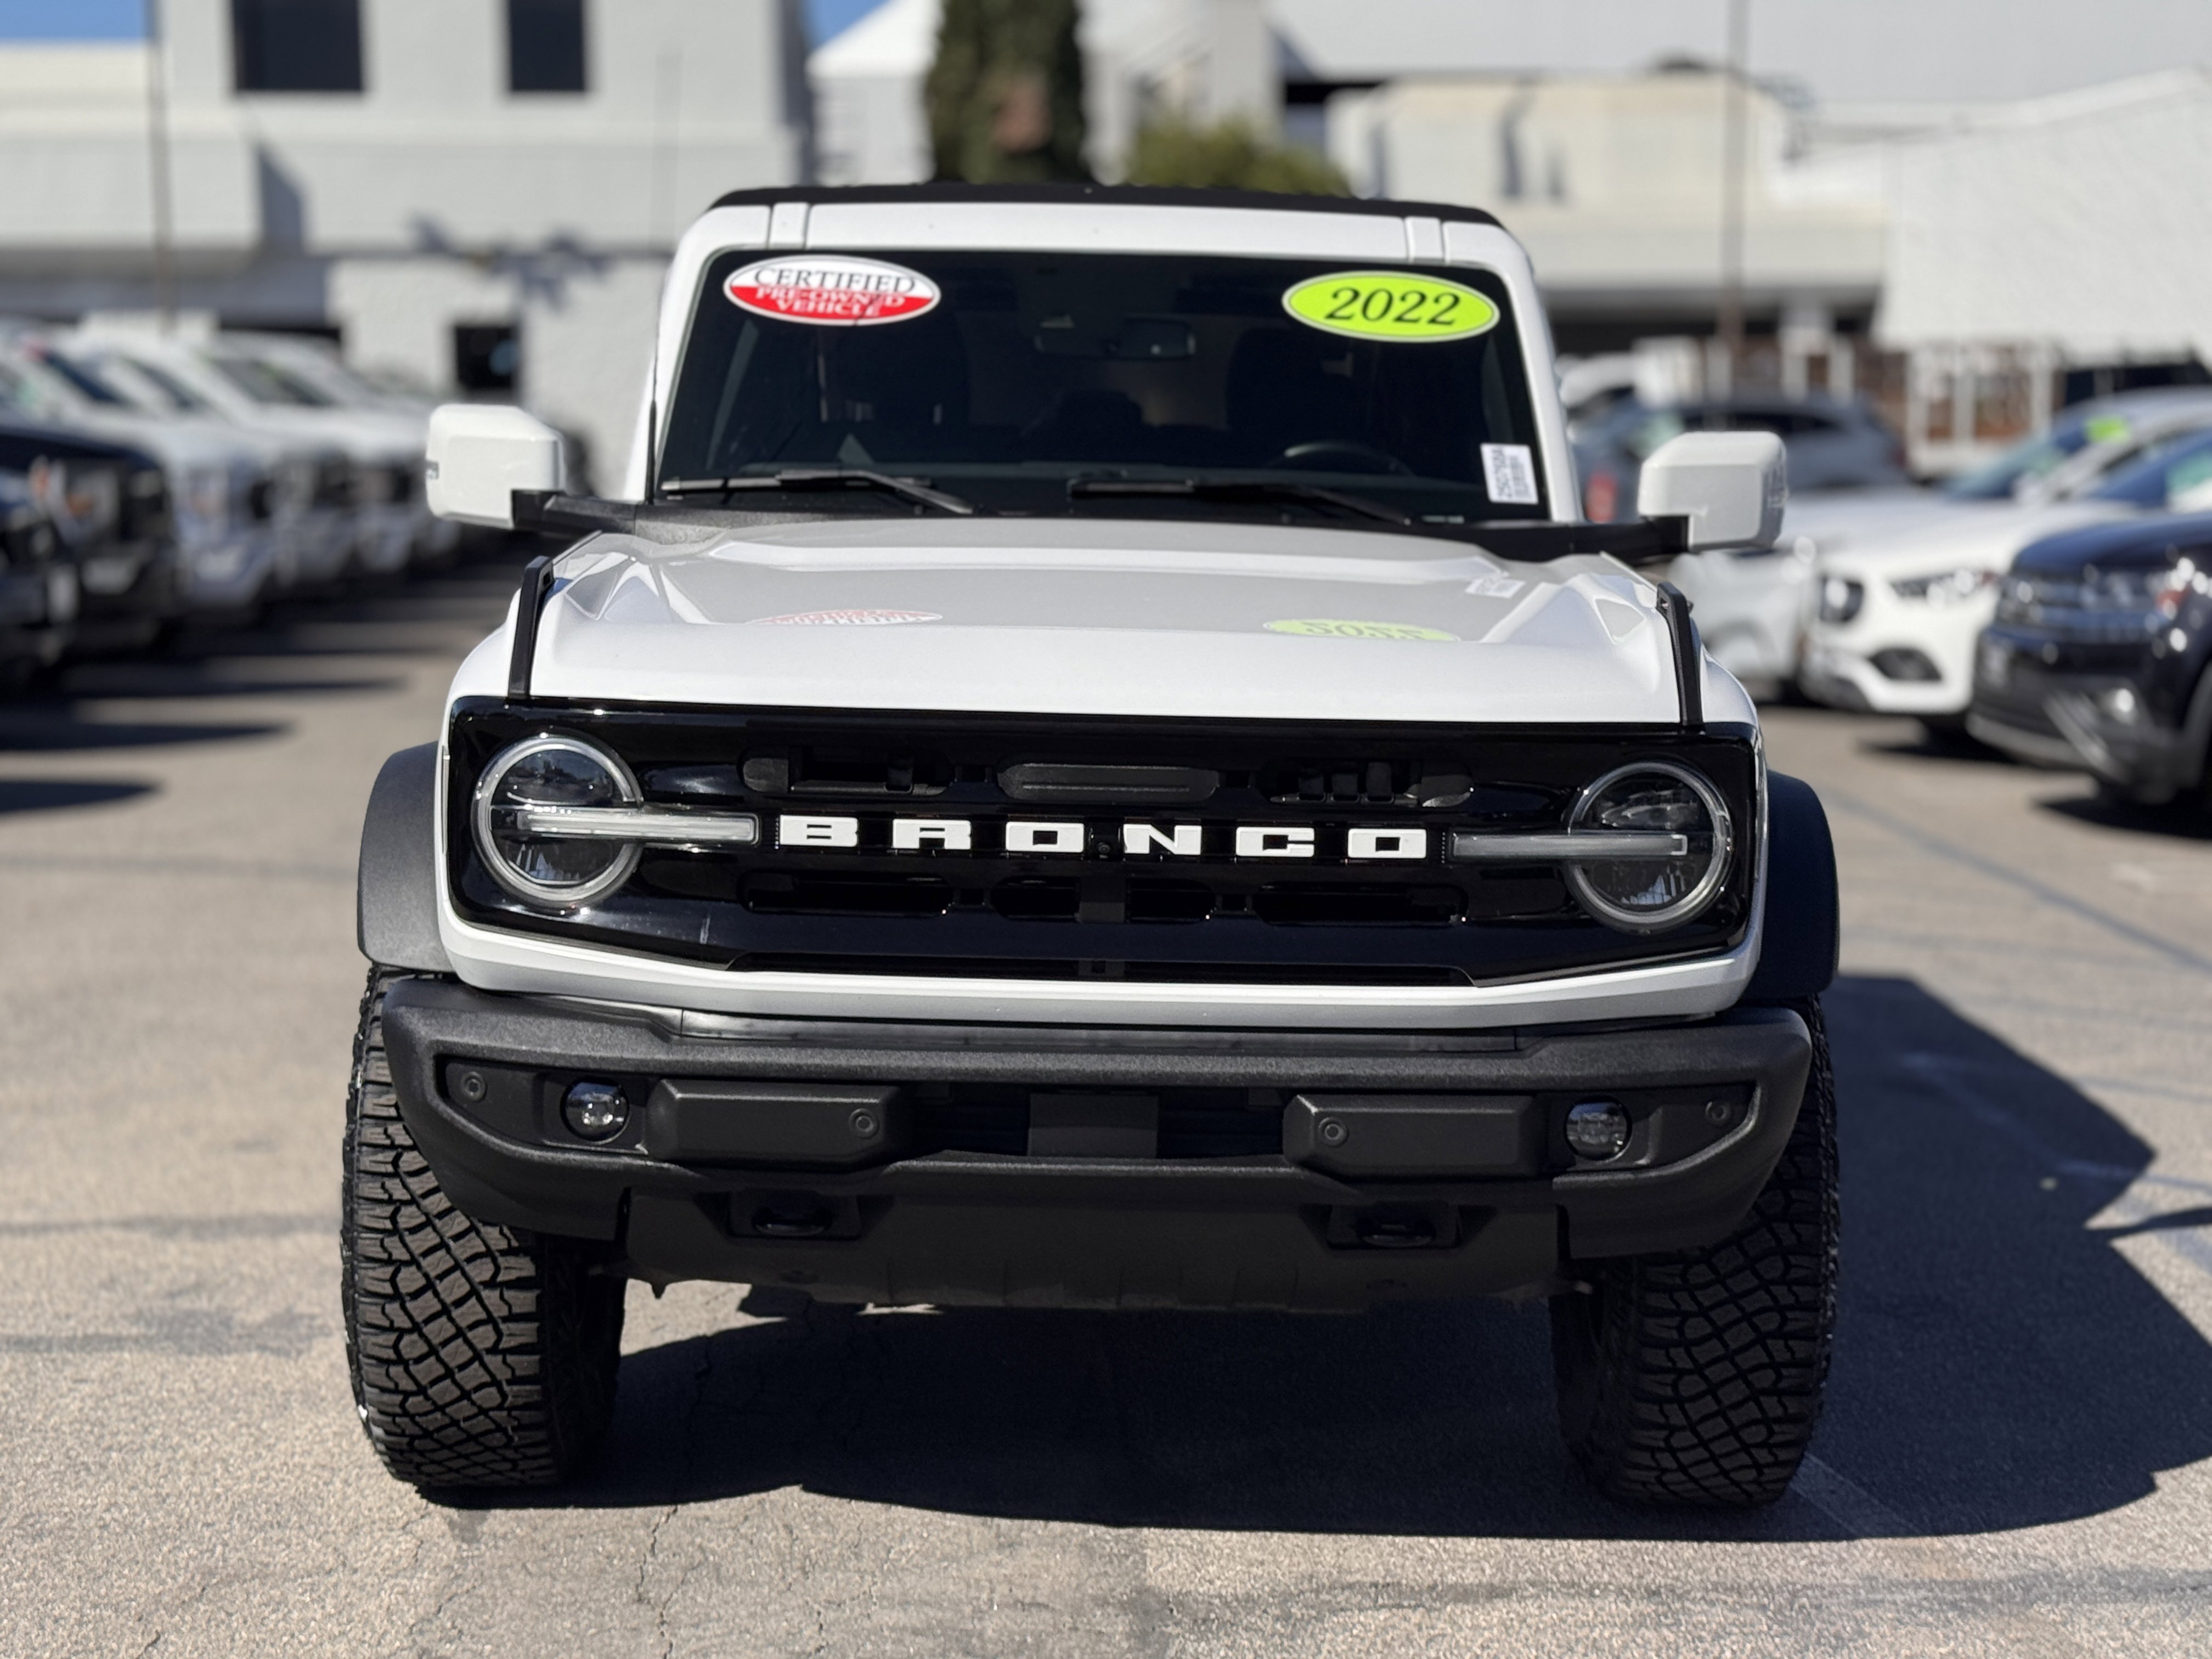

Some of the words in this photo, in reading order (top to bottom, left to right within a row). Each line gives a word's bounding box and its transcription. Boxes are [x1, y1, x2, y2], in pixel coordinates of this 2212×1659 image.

[754, 268, 915, 293] CERTIFIED
[776, 298, 880, 317] VEHICLE
[1324, 287, 1460, 325] 2022
[780, 815, 1426, 859] BRONCO
